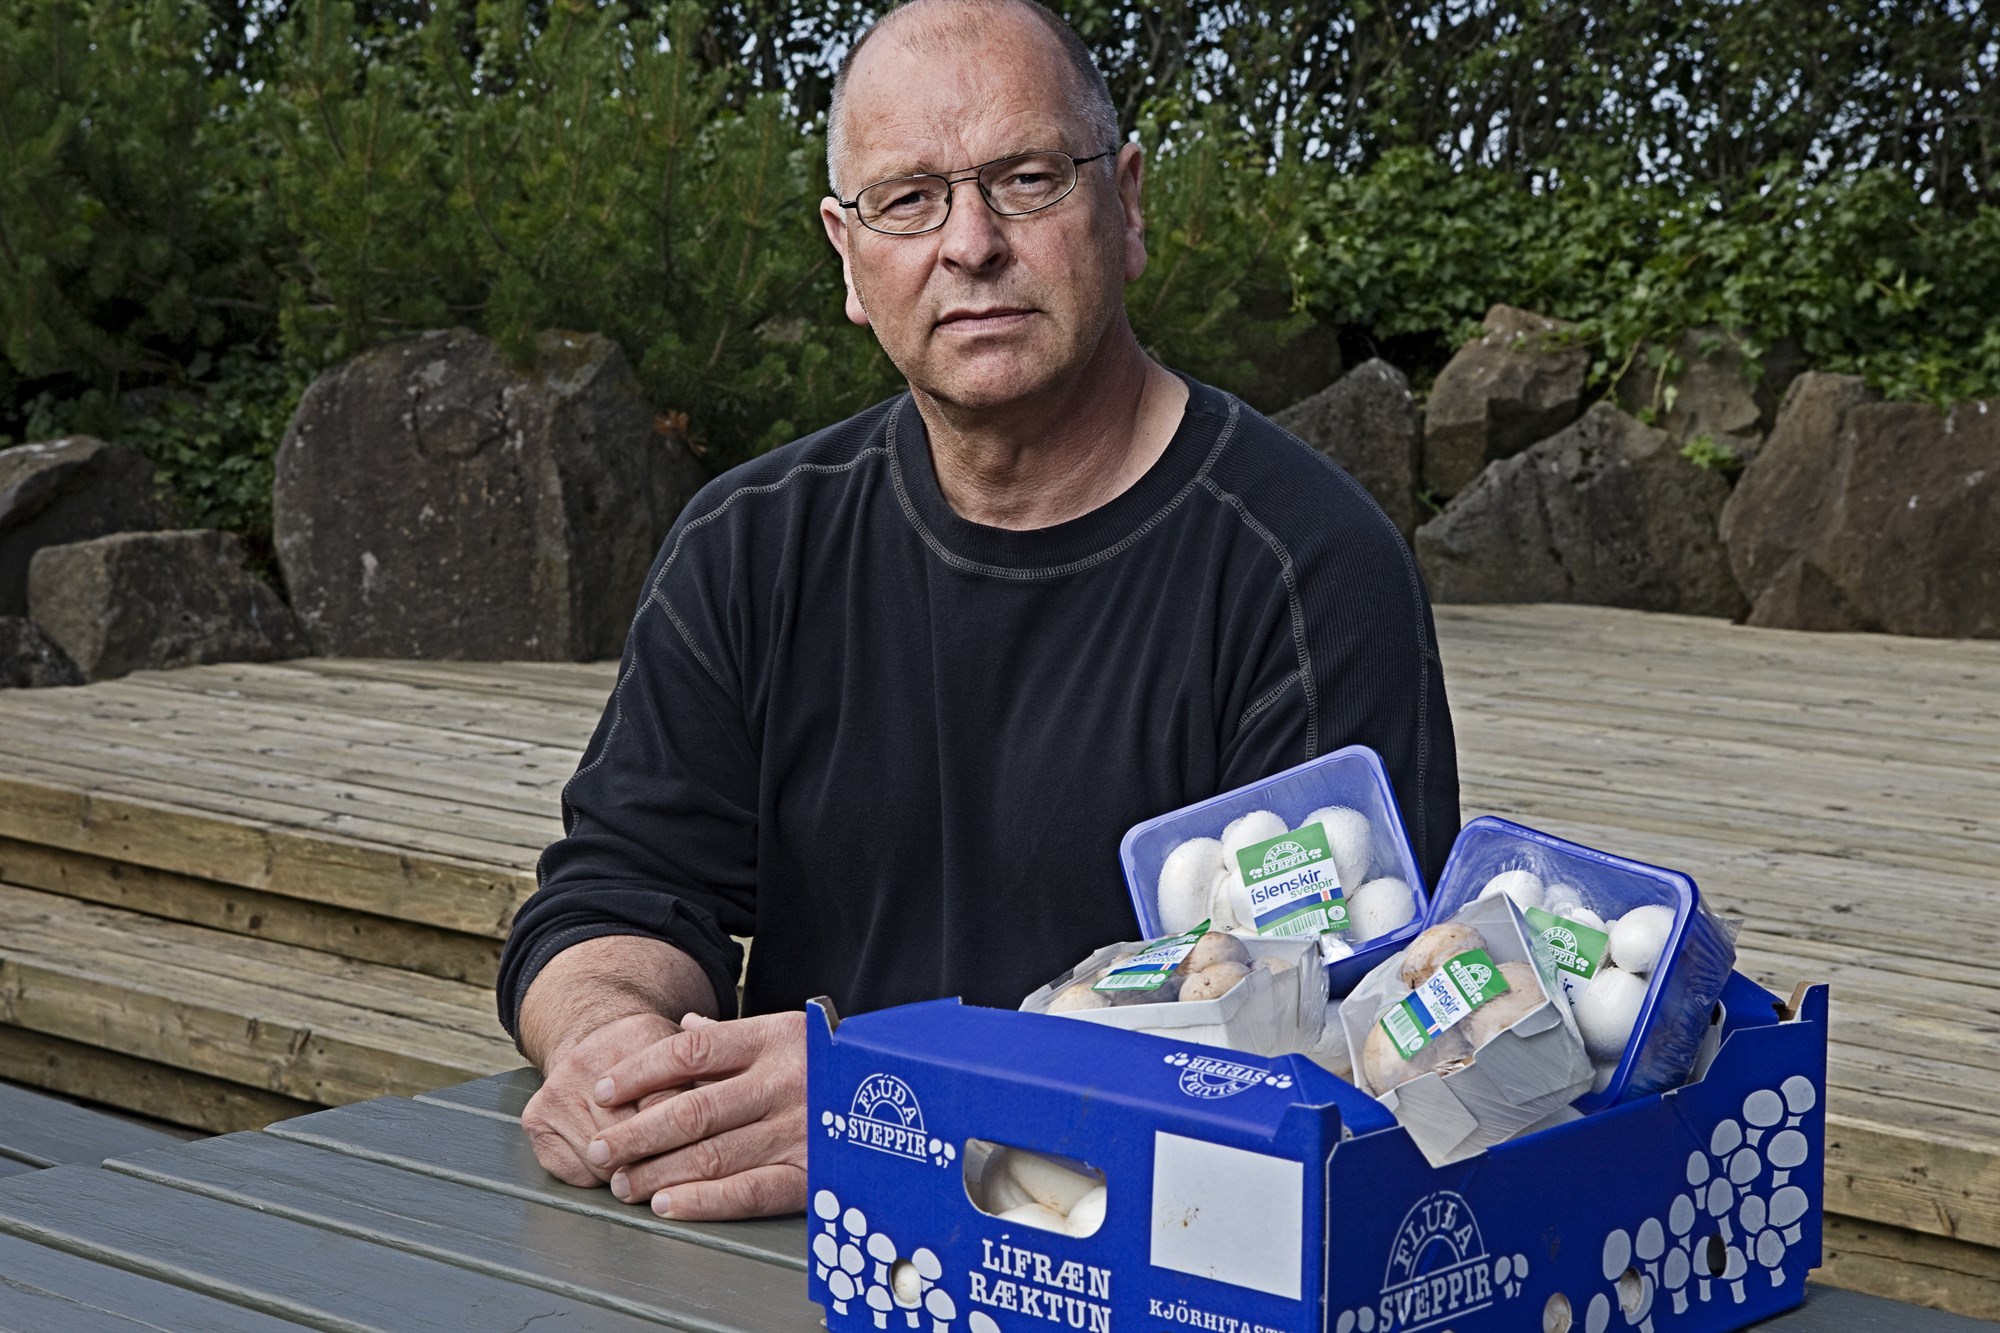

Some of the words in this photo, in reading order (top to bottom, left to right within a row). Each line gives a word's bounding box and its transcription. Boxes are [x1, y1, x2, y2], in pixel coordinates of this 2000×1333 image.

[1263, 852, 1309, 875] SVEPPIR
[1251, 870, 1321, 905] íslenskir
[1290, 878, 1334, 898] sveppir
[1428, 973, 1460, 1015] íslenskir
[1187, 1057, 1267, 1084] SVEPPIR
[848, 1117, 927, 1157] SVEPPIR
[982, 1234, 1112, 1300] LÍFRÆN
[968, 1271, 1112, 1333] RÆKTUN
[1149, 1299, 1286, 1333] KJÖRHITAS
[1379, 1263, 1493, 1333] SVEPPIR
